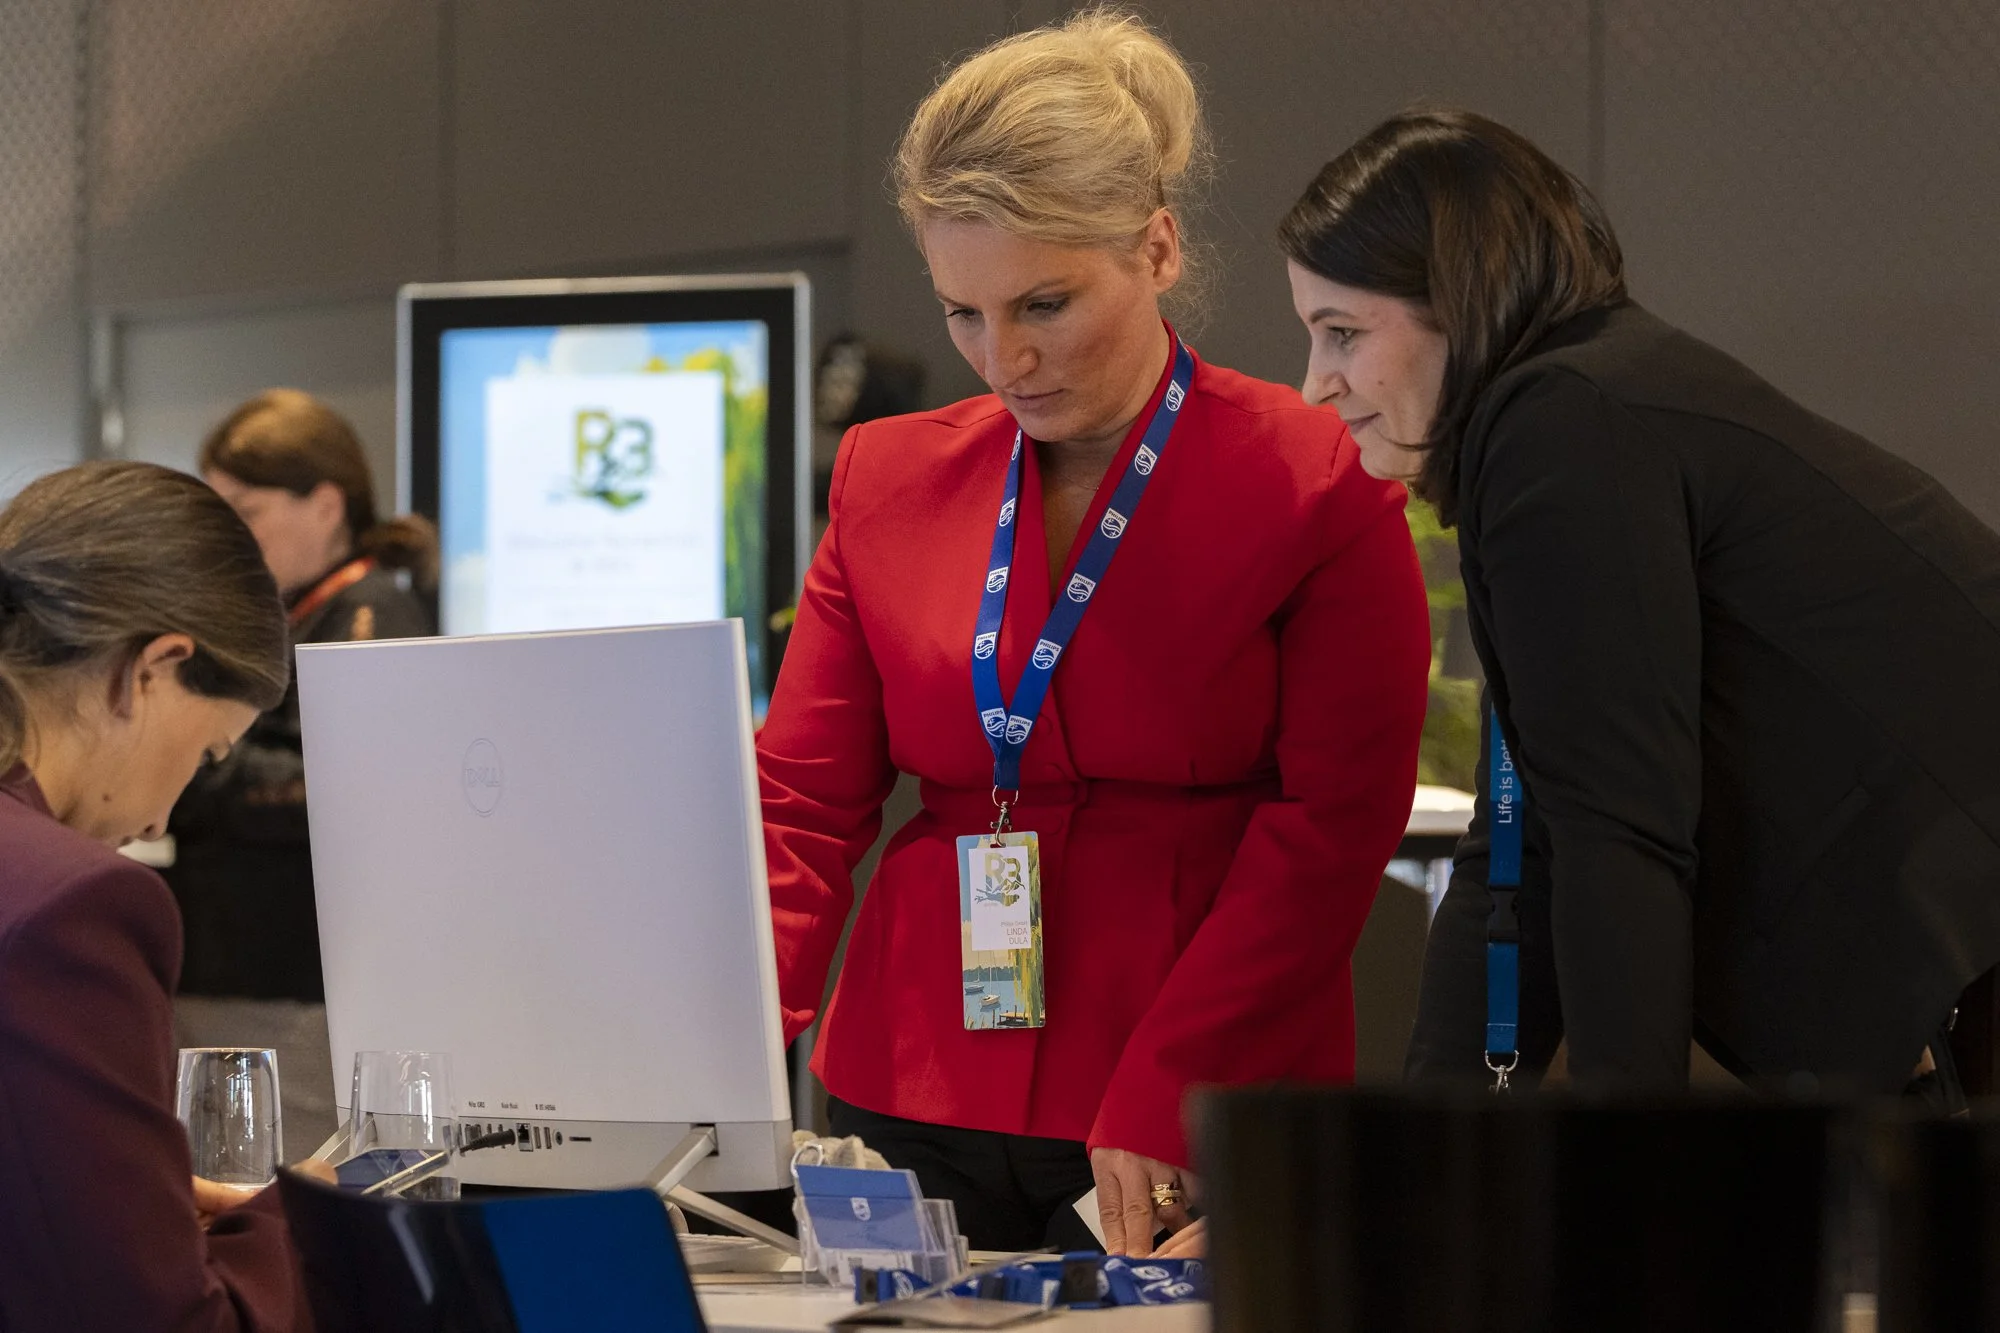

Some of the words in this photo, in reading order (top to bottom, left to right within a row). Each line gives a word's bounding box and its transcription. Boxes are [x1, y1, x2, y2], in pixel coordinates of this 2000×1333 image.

[1108, 510, 1126, 524] PHILIPS
[1074, 575, 1094, 588] PHILIPS
[1039, 641, 1060, 653] PHILIPS
[983, 709, 1004, 718] PHILIPS
[1010, 717, 1031, 727] PHILIPS
[1499, 776, 1513, 790] is
[1498, 794, 1512, 824] Life
[1006, 927, 1028, 936] LINDA
